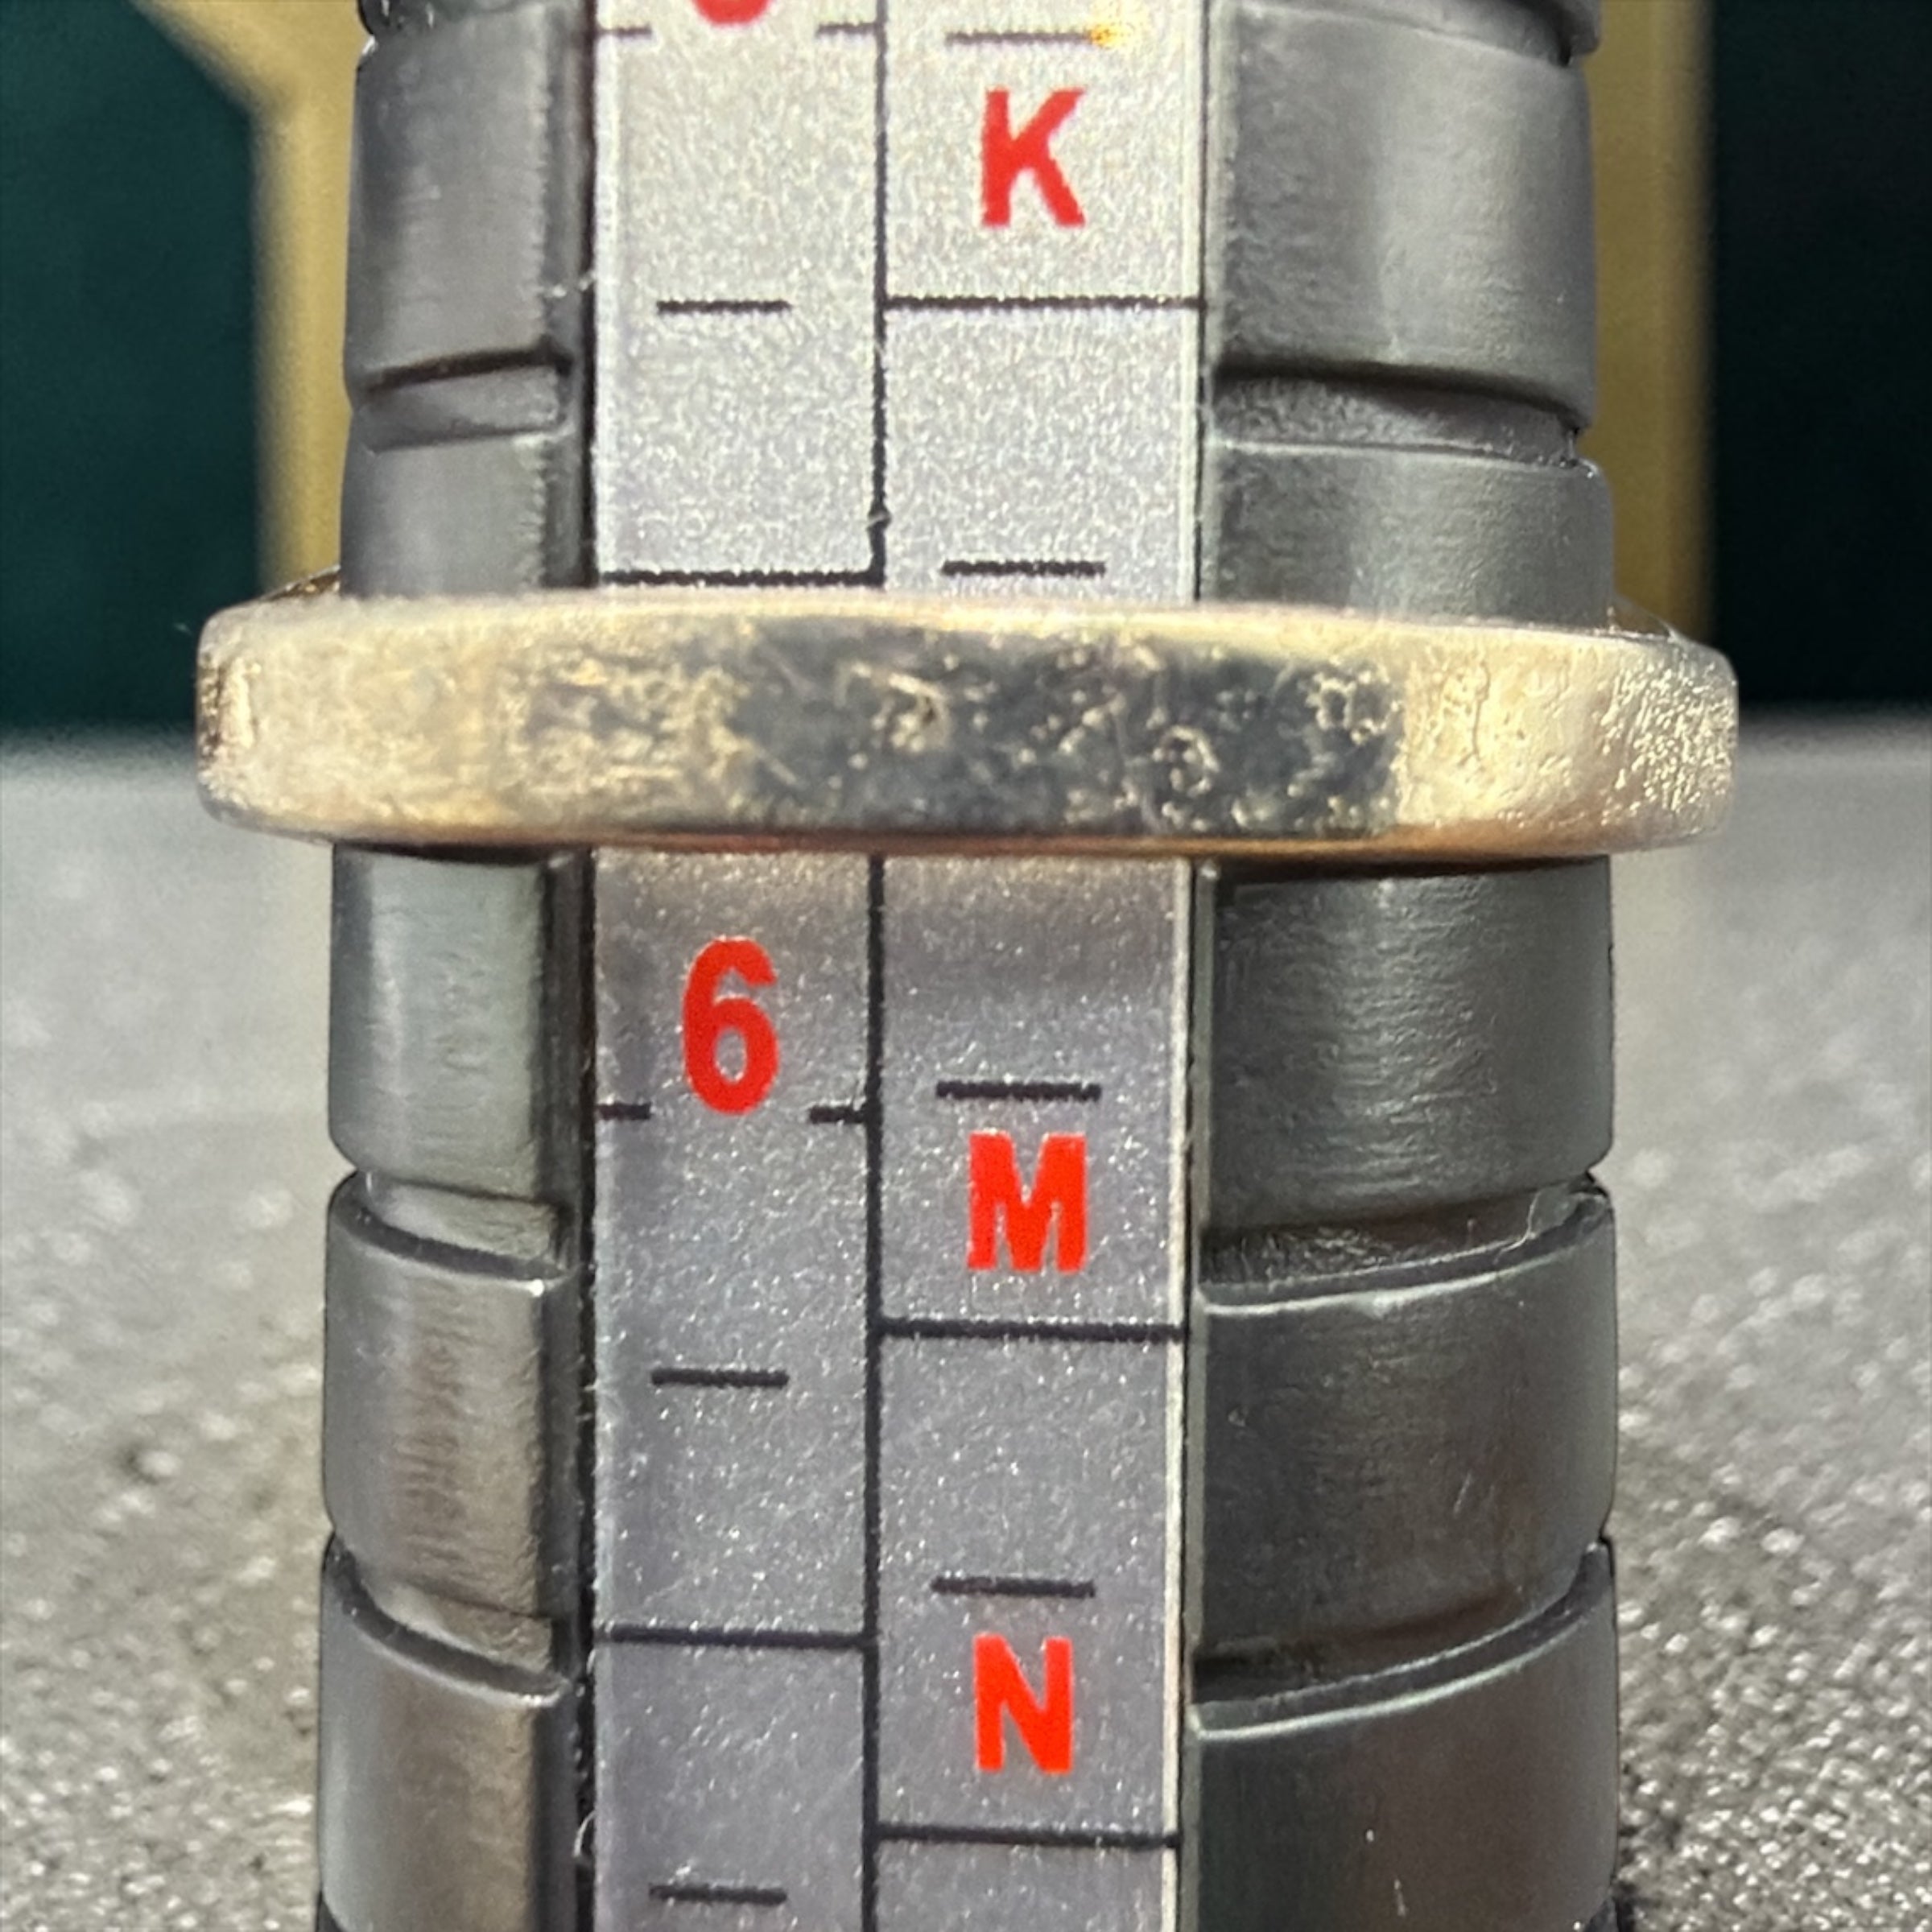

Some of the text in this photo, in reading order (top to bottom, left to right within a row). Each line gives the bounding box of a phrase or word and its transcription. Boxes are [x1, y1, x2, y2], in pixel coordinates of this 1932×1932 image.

[980, 88, 1086, 229] K
[681, 938, 781, 1117] 6
[966, 1132, 1090, 1274] M
[972, 1633, 1076, 1776] N
